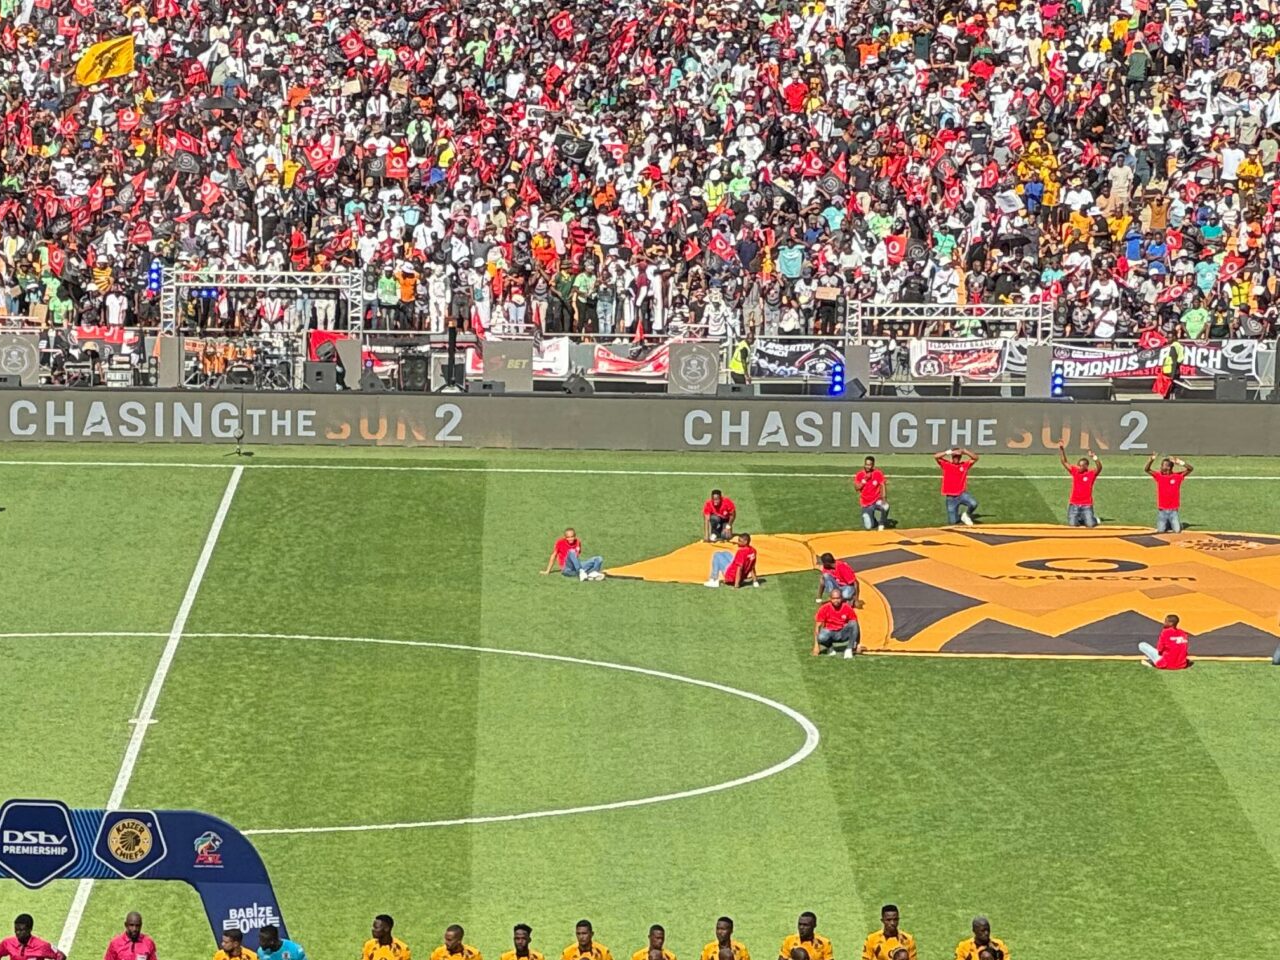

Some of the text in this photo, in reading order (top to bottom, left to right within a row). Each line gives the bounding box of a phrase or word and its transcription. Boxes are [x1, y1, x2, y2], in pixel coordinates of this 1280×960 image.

[506, 359, 529, 370] BET
[9, 399, 239, 438] CHASING
[246, 408, 317, 437] THE
[434, 403, 463, 441] 2
[683, 409, 918, 449] CHASING
[925, 418, 998, 447] THE
[1119, 411, 1149, 450] 2
[980, 574, 1198, 582] vodacom
[116, 821, 145, 835] KAIZER
[3, 830, 68, 845] DStv
[2, 845, 68, 855] PREMIERSHIP
[114, 847, 145, 860] CHIEFS
[229, 902, 274, 919] BABIZE
[223, 916, 280, 934] BONKE
